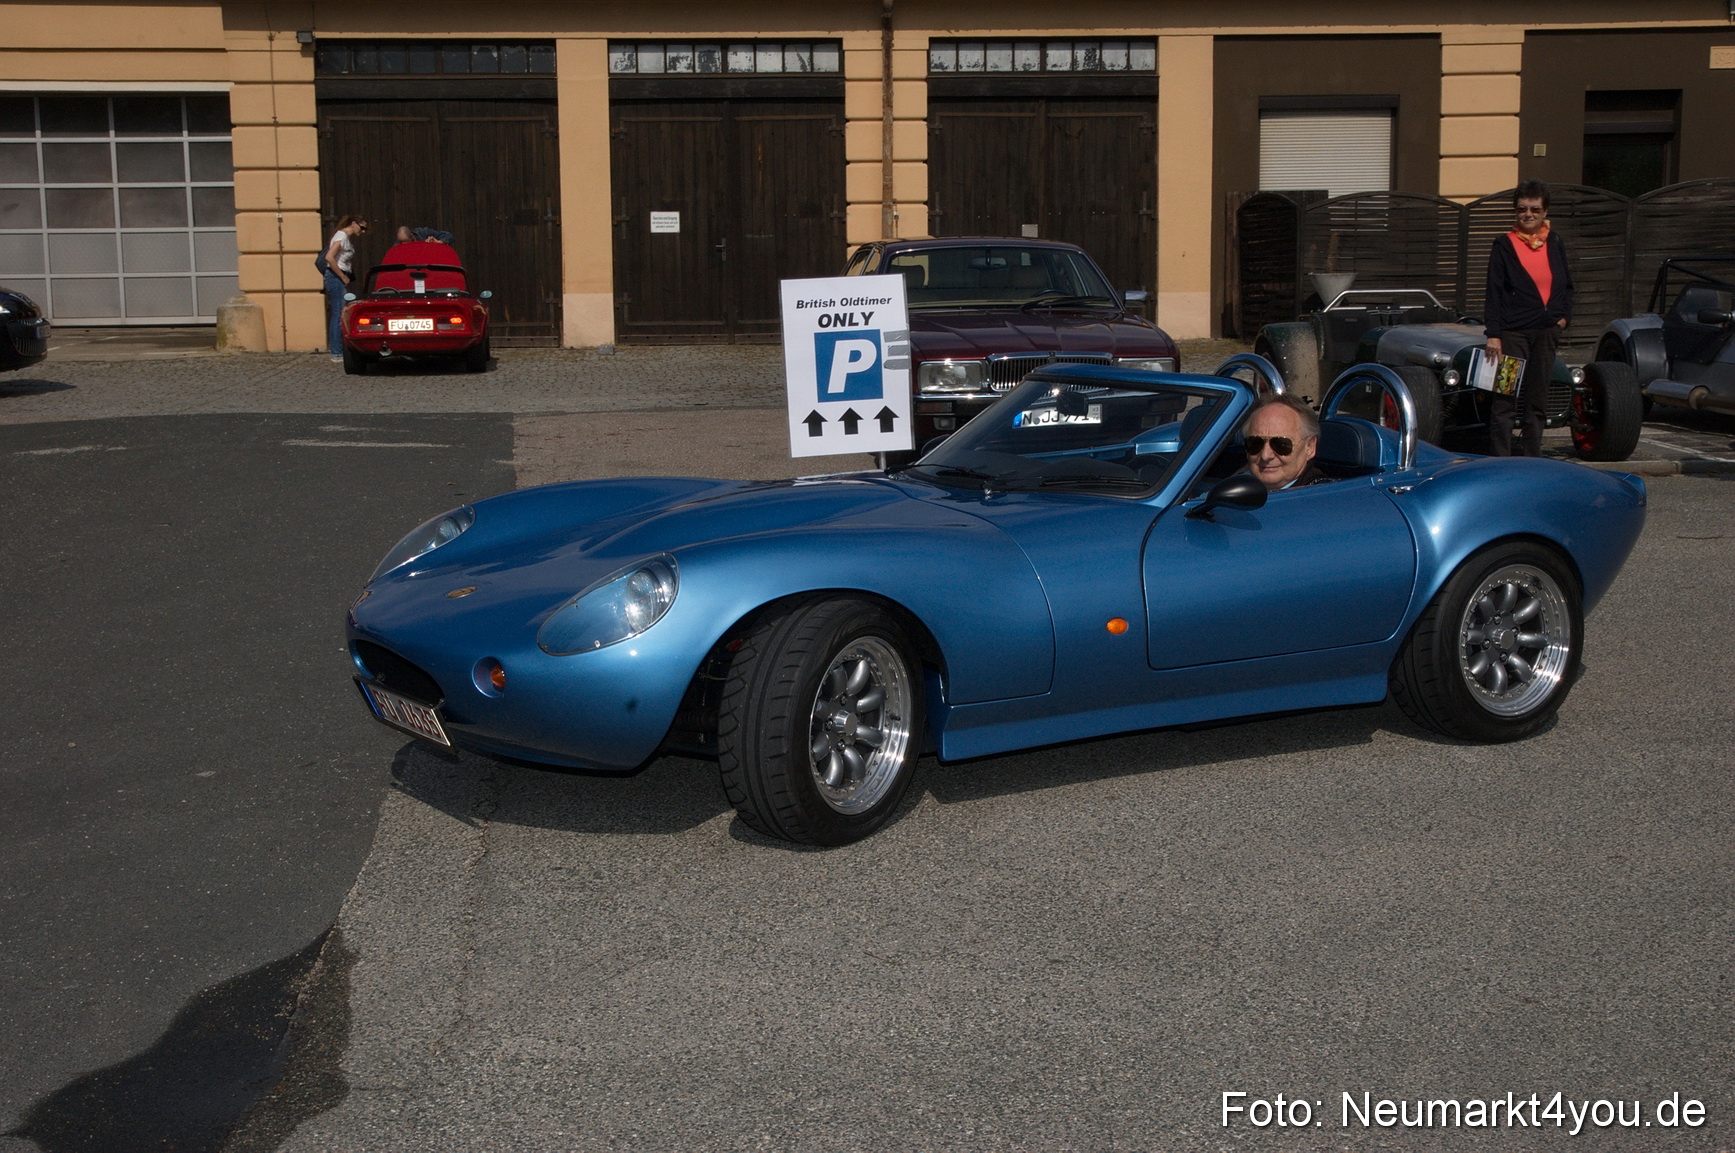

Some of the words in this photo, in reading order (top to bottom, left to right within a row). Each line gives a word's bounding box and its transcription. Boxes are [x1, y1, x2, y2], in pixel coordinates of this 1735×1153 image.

[796, 298, 836, 309] British
[840, 297, 892, 307] Oldtimer
[409, 320, 432, 330] 0745
[818, 311, 875, 328] ONLY
[827, 338, 878, 394] P
[398, 699, 442, 738] 0635
